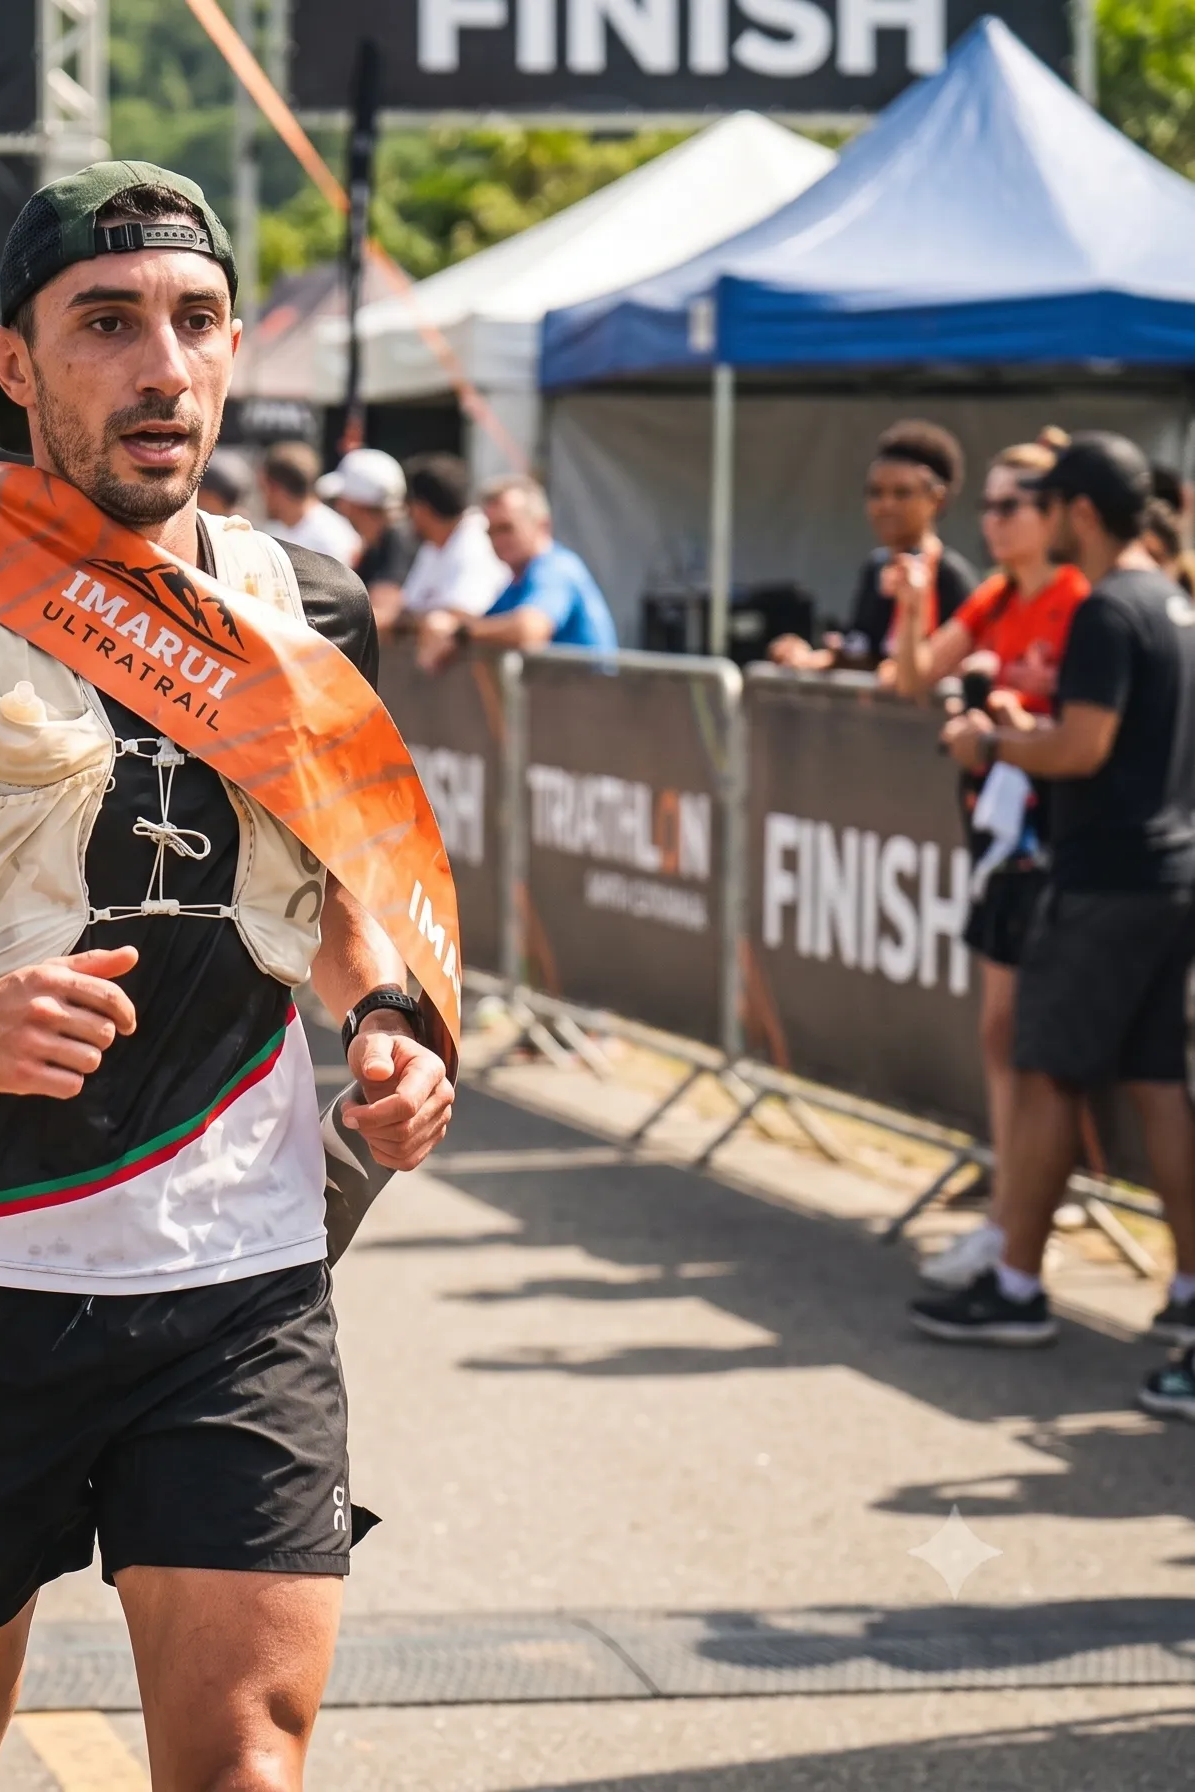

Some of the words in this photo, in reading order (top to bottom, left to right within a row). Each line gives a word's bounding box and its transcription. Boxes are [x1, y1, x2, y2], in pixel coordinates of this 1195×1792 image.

[417, 0, 947, 76] FINISH
[42, 600, 219, 731] ULTRATRAIL
[61, 570, 236, 699] IMARUI
[763, 811, 971, 997] FINISH
